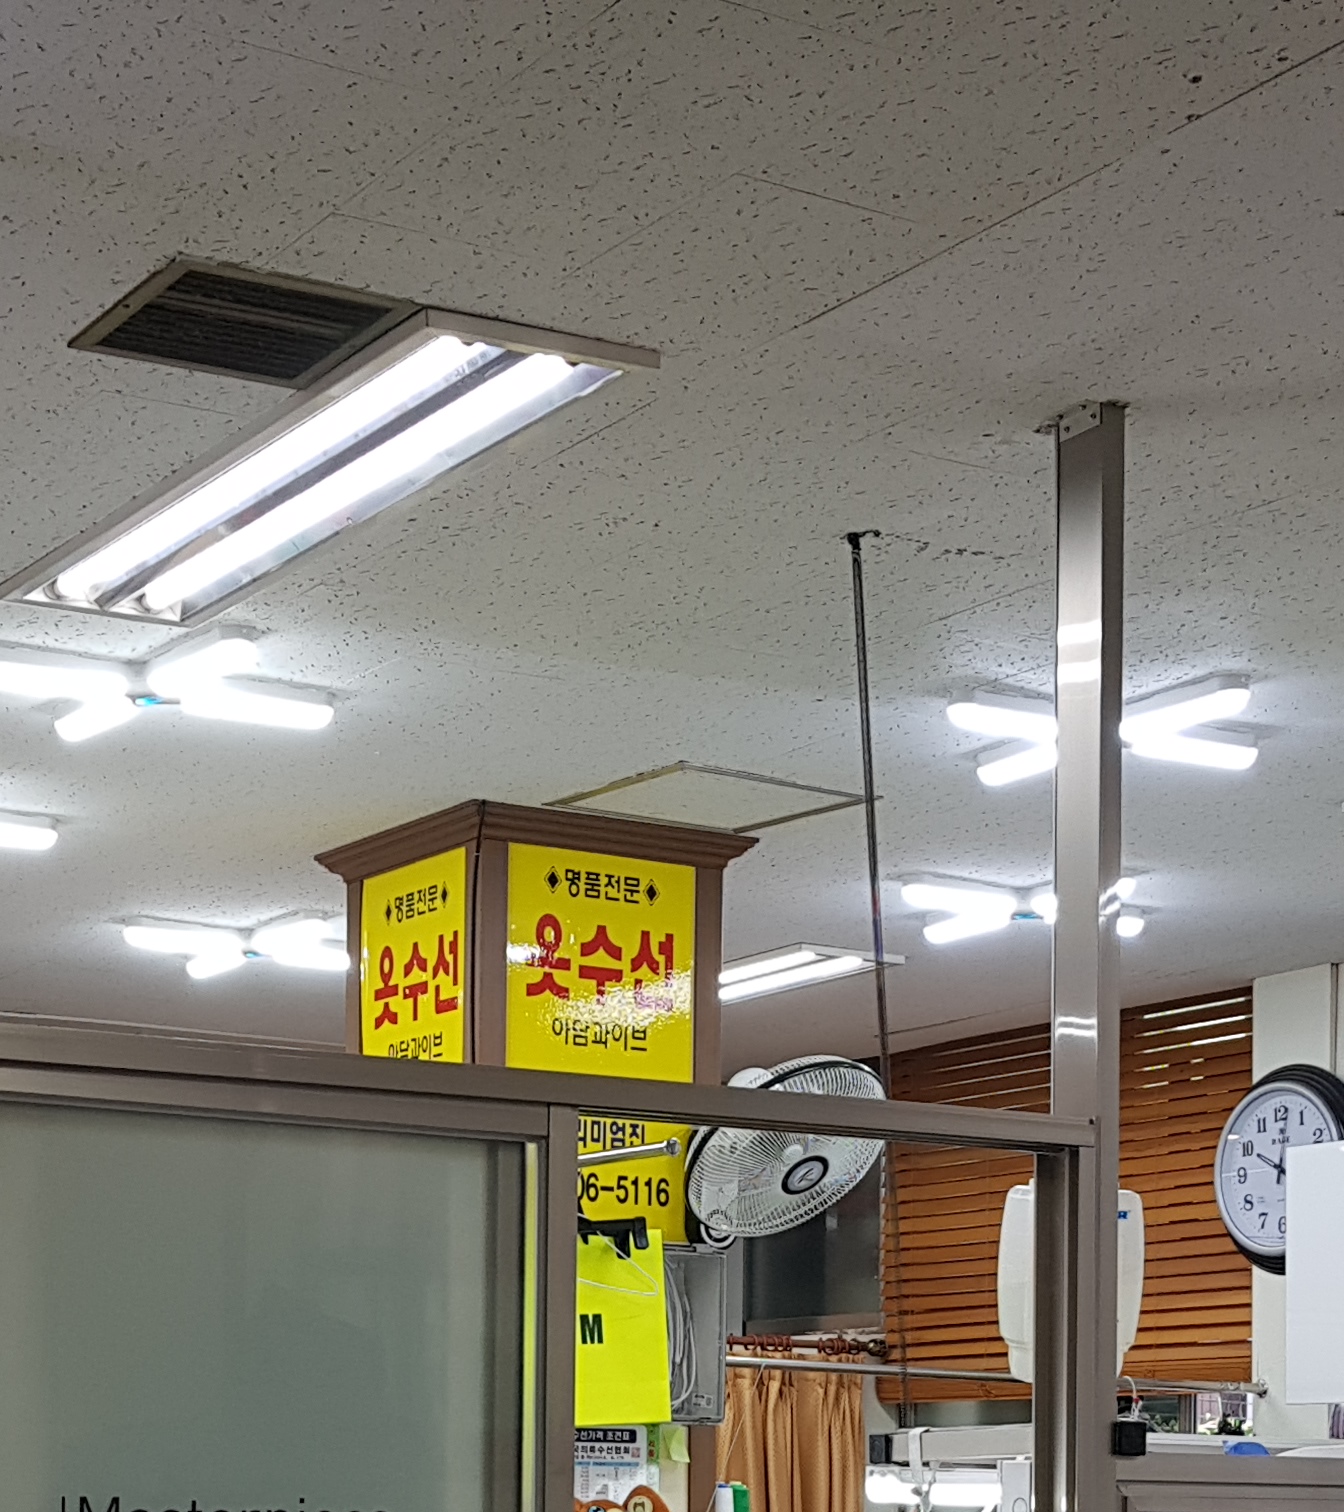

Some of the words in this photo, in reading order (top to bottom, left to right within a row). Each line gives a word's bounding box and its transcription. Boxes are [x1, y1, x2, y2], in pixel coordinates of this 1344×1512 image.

[564, 868, 642, 905] 명품전문
[394, 884, 438, 922] 명품전문
[526, 913, 675, 1011] 옷수선
[374, 930, 458, 1030] 옷수선
[552, 1018, 648, 1053] 아담과이브
[1273, 1104, 1289, 1123] 12
[1298, 1110, 1305, 1126] 1
[1257, 1117, 1268, 1133] 11
[1312, 1128, 1325, 1144] 2
[1242, 1140, 1254, 1157] 10
[1237, 1167, 1247, 1184] 9
[1243, 1194, 1254, 1211] 8
[1258, 1212, 1268, 1230] 7
[580, 1313, 604, 1345] M
